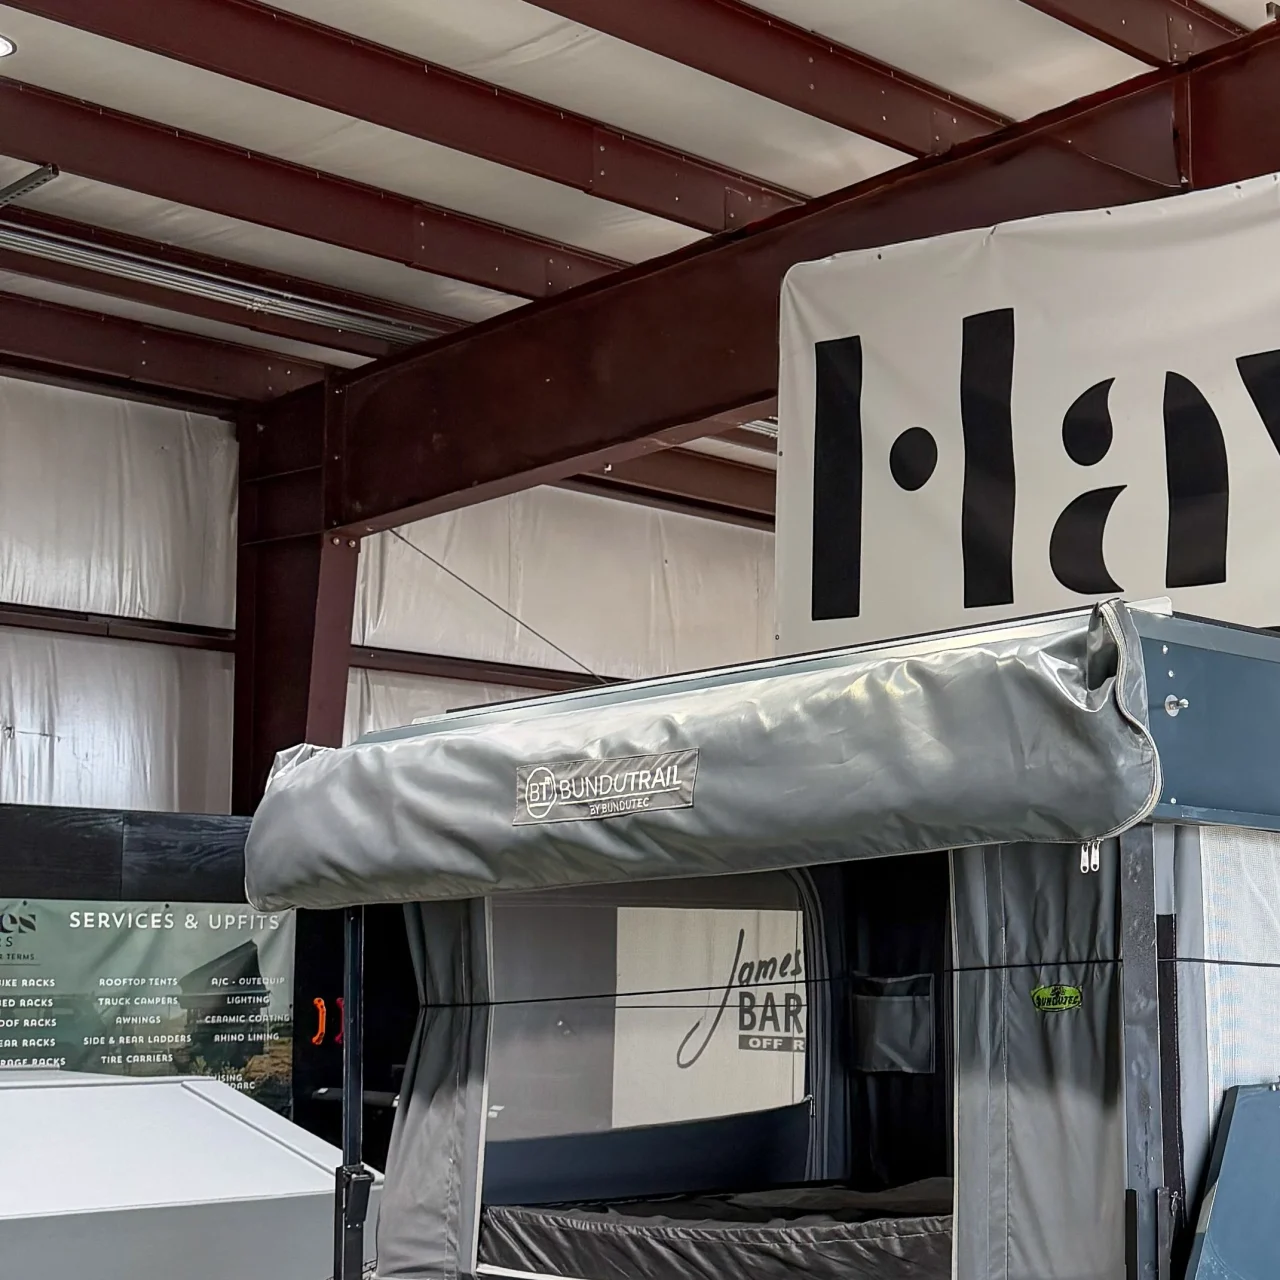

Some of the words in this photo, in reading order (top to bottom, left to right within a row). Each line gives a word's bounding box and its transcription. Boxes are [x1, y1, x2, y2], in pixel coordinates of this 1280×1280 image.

[559, 765, 682, 800] BUNDUTRAIL
[590, 804, 600, 815] BY
[602, 797, 649, 814] BUNDUTEC
[69, 911, 174, 929] SERVICES
[184, 914, 198, 929] &
[209, 914, 280, 930] UPFITS
[0, 979, 17, 987] IKE
[22, 978, 55, 987] RACKS
[99, 978, 146, 986] ROOFTOP
[149, 977, 178, 986] TENTS
[211, 977, 229, 987] A/C
[238, 977, 285, 985] OUTEQUIP
[0, 999, 16, 1007] ED
[20, 998, 53, 1007] RACKS
[98, 997, 131, 1006] TRUCK
[134, 997, 178, 1005] CAMPERS
[226, 995, 270, 1004] LIGHTING
[677, 929, 802, 1068] James
[739, 991, 803, 1034] BAR
[23, 1018, 57, 1027] RACKS
[115, 1015, 161, 1024] AWNINGS
[204, 1014, 246, 1023] CERAMIC
[248, 1013, 290, 1022] COATING
[83, 1036, 105, 1045] SIDE
[108, 1036, 115, 1044] &
[119, 1035, 144, 1044] REAR
[148, 1034, 192, 1043] LADDERS
[214, 1033, 245, 1042] RHINO
[247, 1032, 280, 1041] LINING
[22, 1038, 56, 1047] RACKS
[748, 1038, 783, 1049] OFF
[32, 1057, 66, 1066] RACKS
[101, 1055, 122, 1064] TIRE
[126, 1053, 173, 1063] CARRIERS
